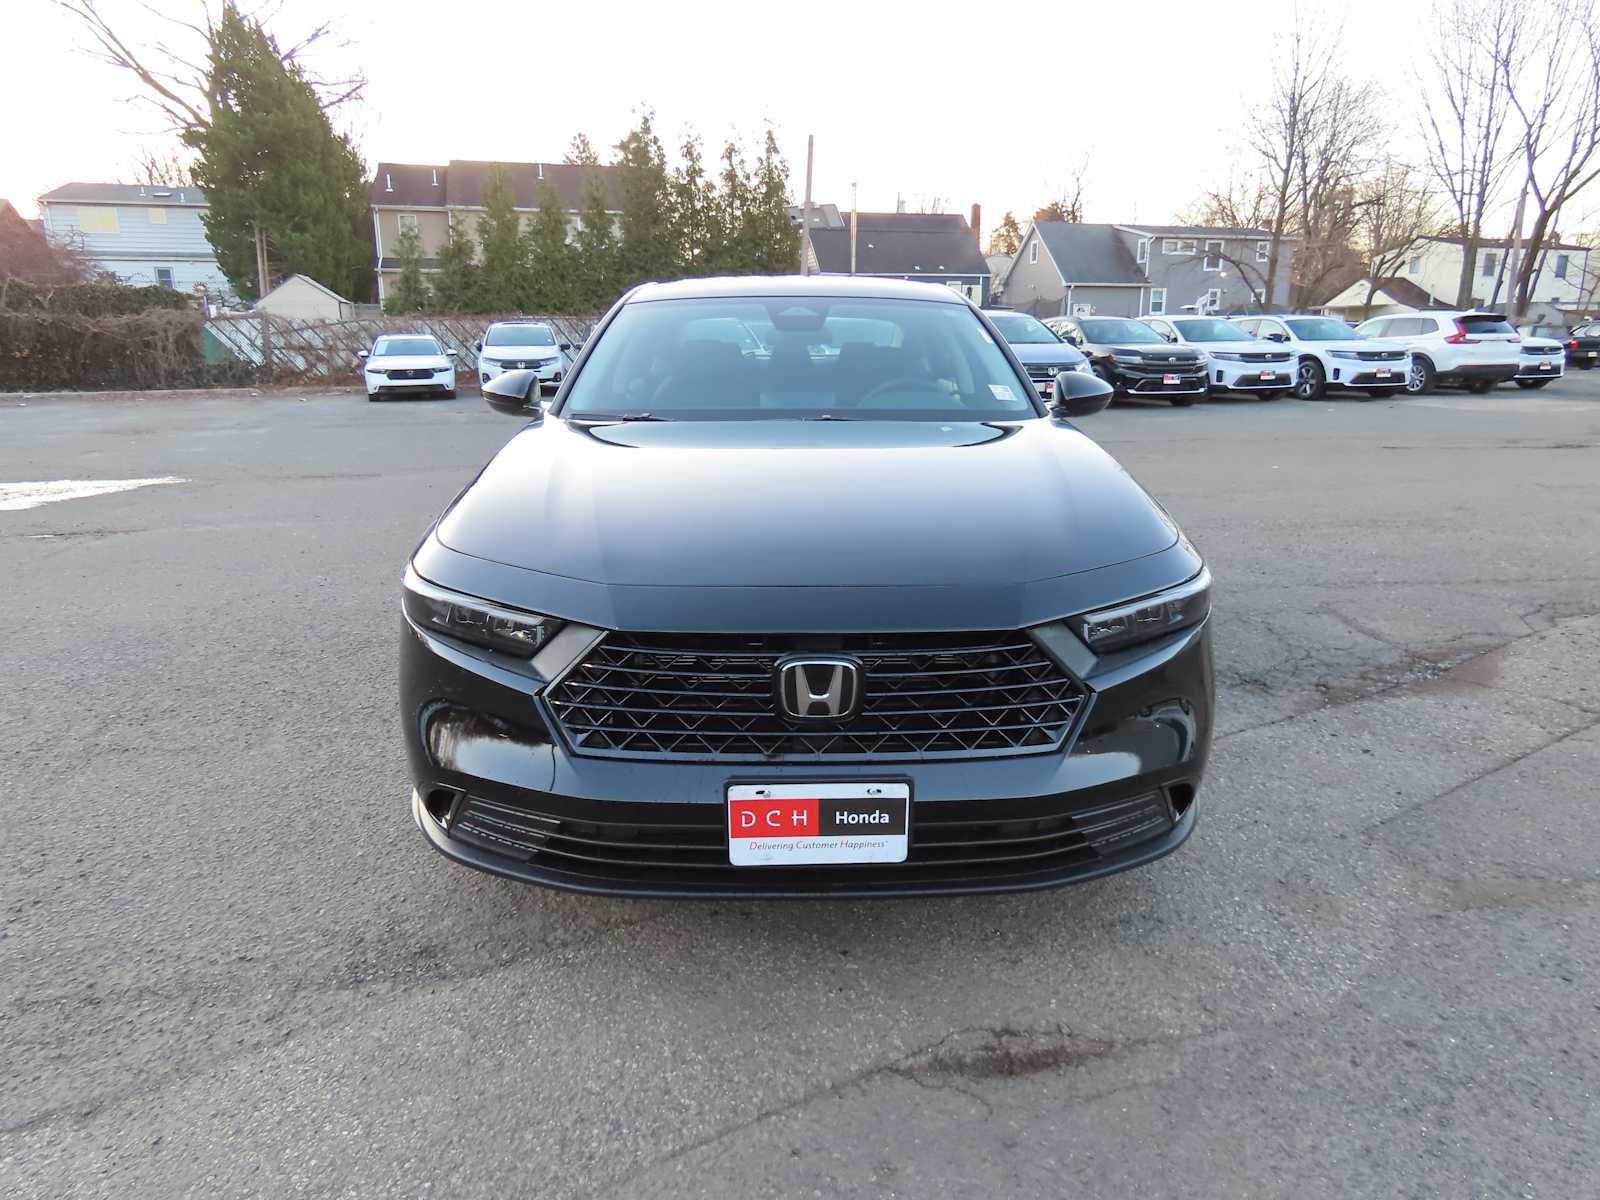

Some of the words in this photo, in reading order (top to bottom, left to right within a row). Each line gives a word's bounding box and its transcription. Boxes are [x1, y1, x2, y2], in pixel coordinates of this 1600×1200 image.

[835, 809, 890, 825] Honda
[749, 841, 794, 852] Delivering
[796, 840, 838, 850] Customer
